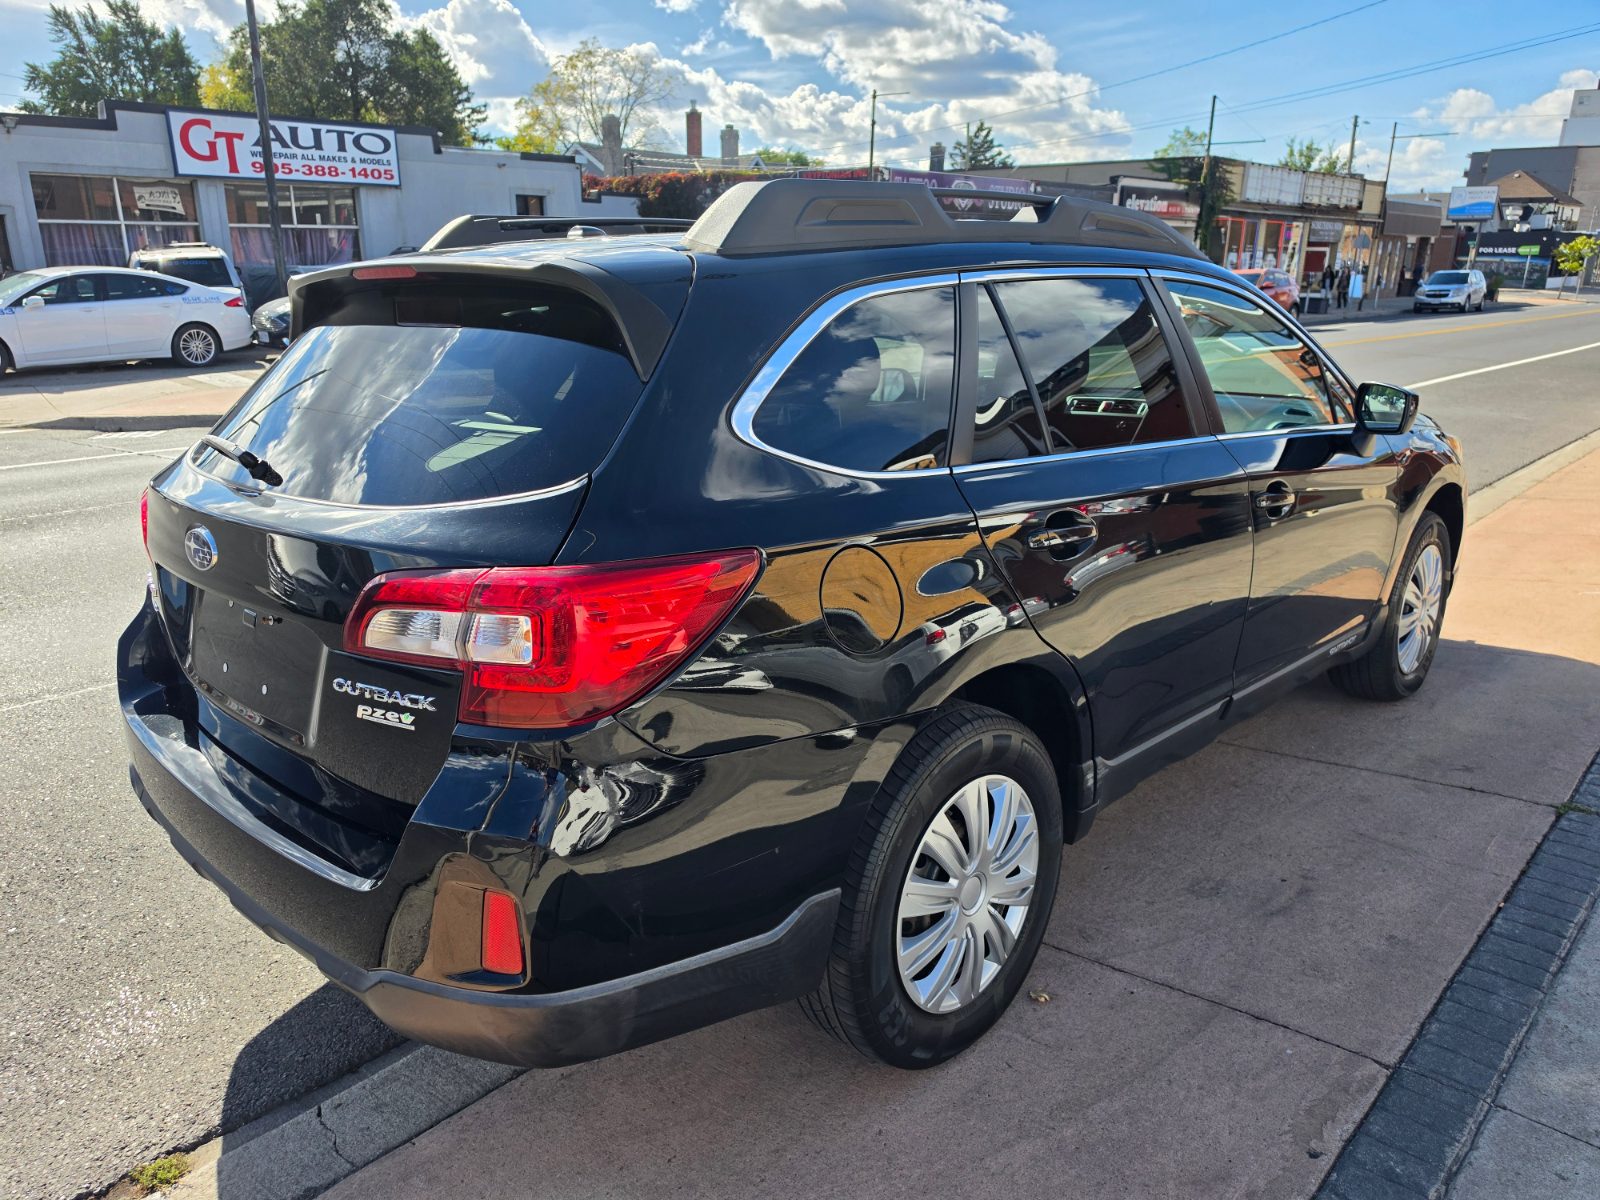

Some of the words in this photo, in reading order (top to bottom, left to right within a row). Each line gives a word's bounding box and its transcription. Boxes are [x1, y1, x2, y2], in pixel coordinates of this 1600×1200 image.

[179, 118, 244, 174] GT
[251, 122, 392, 155] AUTO
[250, 150, 263, 158] WE
[271, 152, 298, 160] EPAIR
[301, 153, 316, 161] ALL
[319, 155, 348, 163] MAKES
[360, 157, 391, 166] MODELS
[1126, 194, 1169, 212] elevation
[332, 677, 437, 712] OUTBACK
